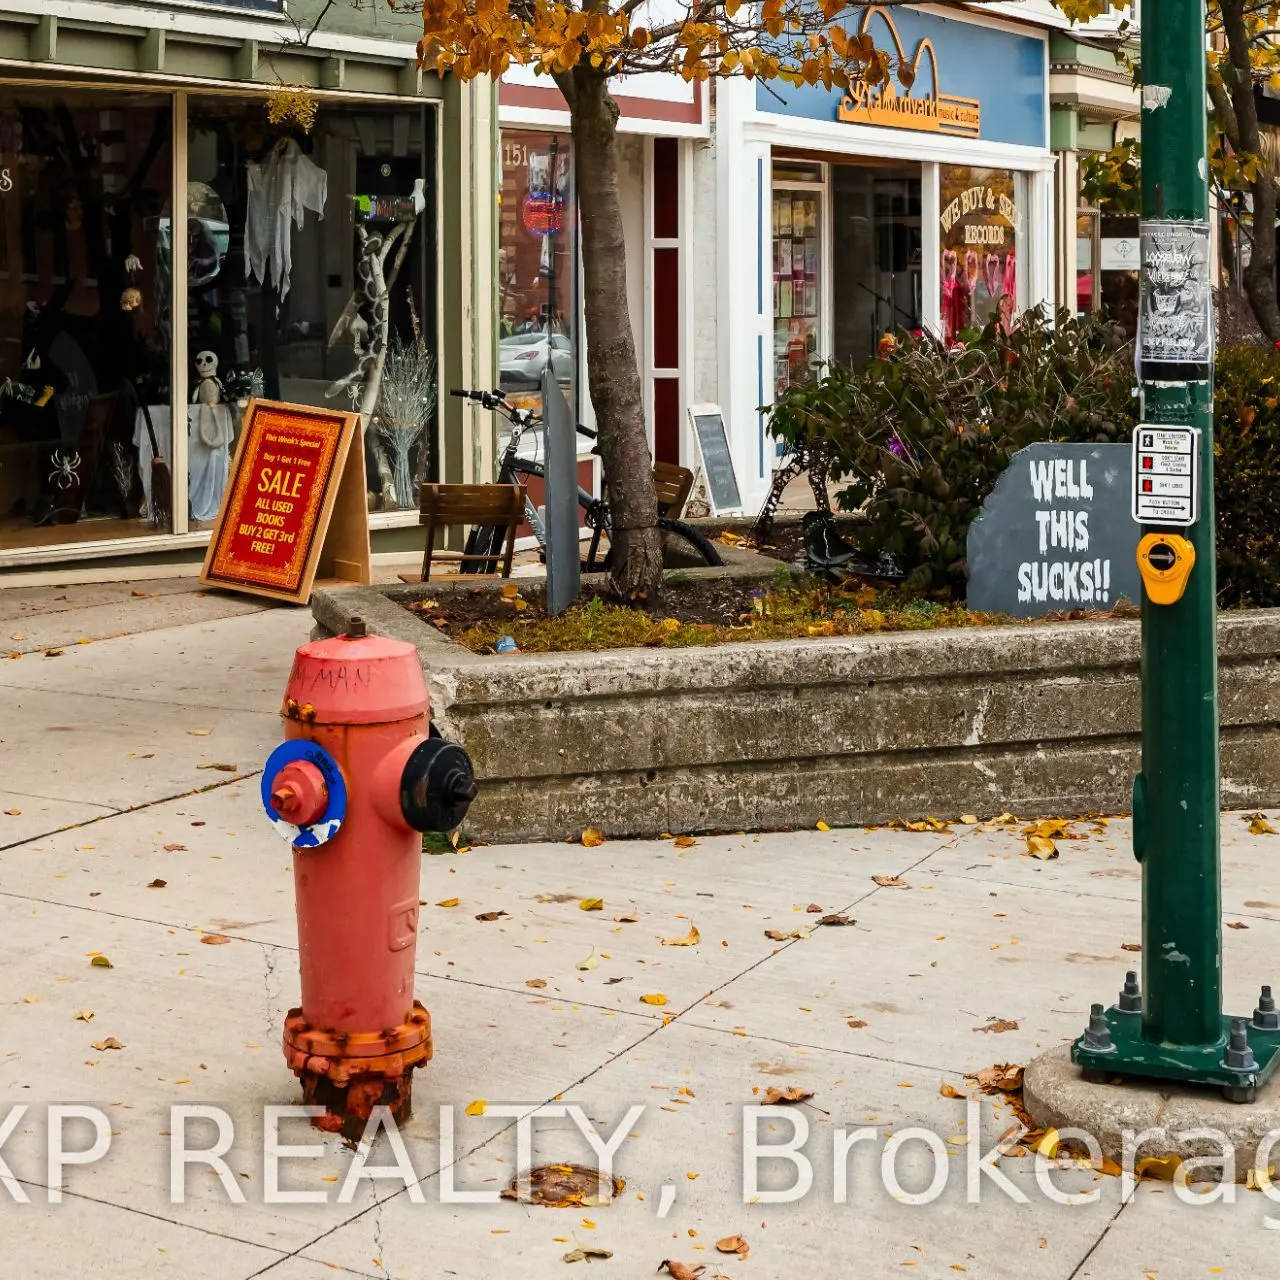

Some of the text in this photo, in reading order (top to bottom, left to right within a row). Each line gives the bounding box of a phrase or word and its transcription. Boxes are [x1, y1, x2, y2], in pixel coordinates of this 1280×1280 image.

[505, 143, 528, 166] 151
[940, 197, 961, 234] WE
[961, 186, 985, 216] BUY
[986, 188, 995, 210] &
[964, 225, 1005, 244] RECORDS
[265, 433, 320, 448] This Week's Special
[263, 452, 276, 462] Buy
[281, 455, 292, 463] Get
[293, 456, 297, 464] 1
[298, 458, 312, 467] Free
[257, 467, 305, 498] SALE
[1029, 458, 1094, 505] WELL
[255, 497, 293, 514] ALL USED
[256, 512, 286, 526] BOOKS
[239, 524, 295, 544] BUY 2 GET 3rd
[1035, 509, 1090, 556] THIS
[250, 541, 275, 555] FREE!
[1017, 558, 1110, 604] SUCKS!!
